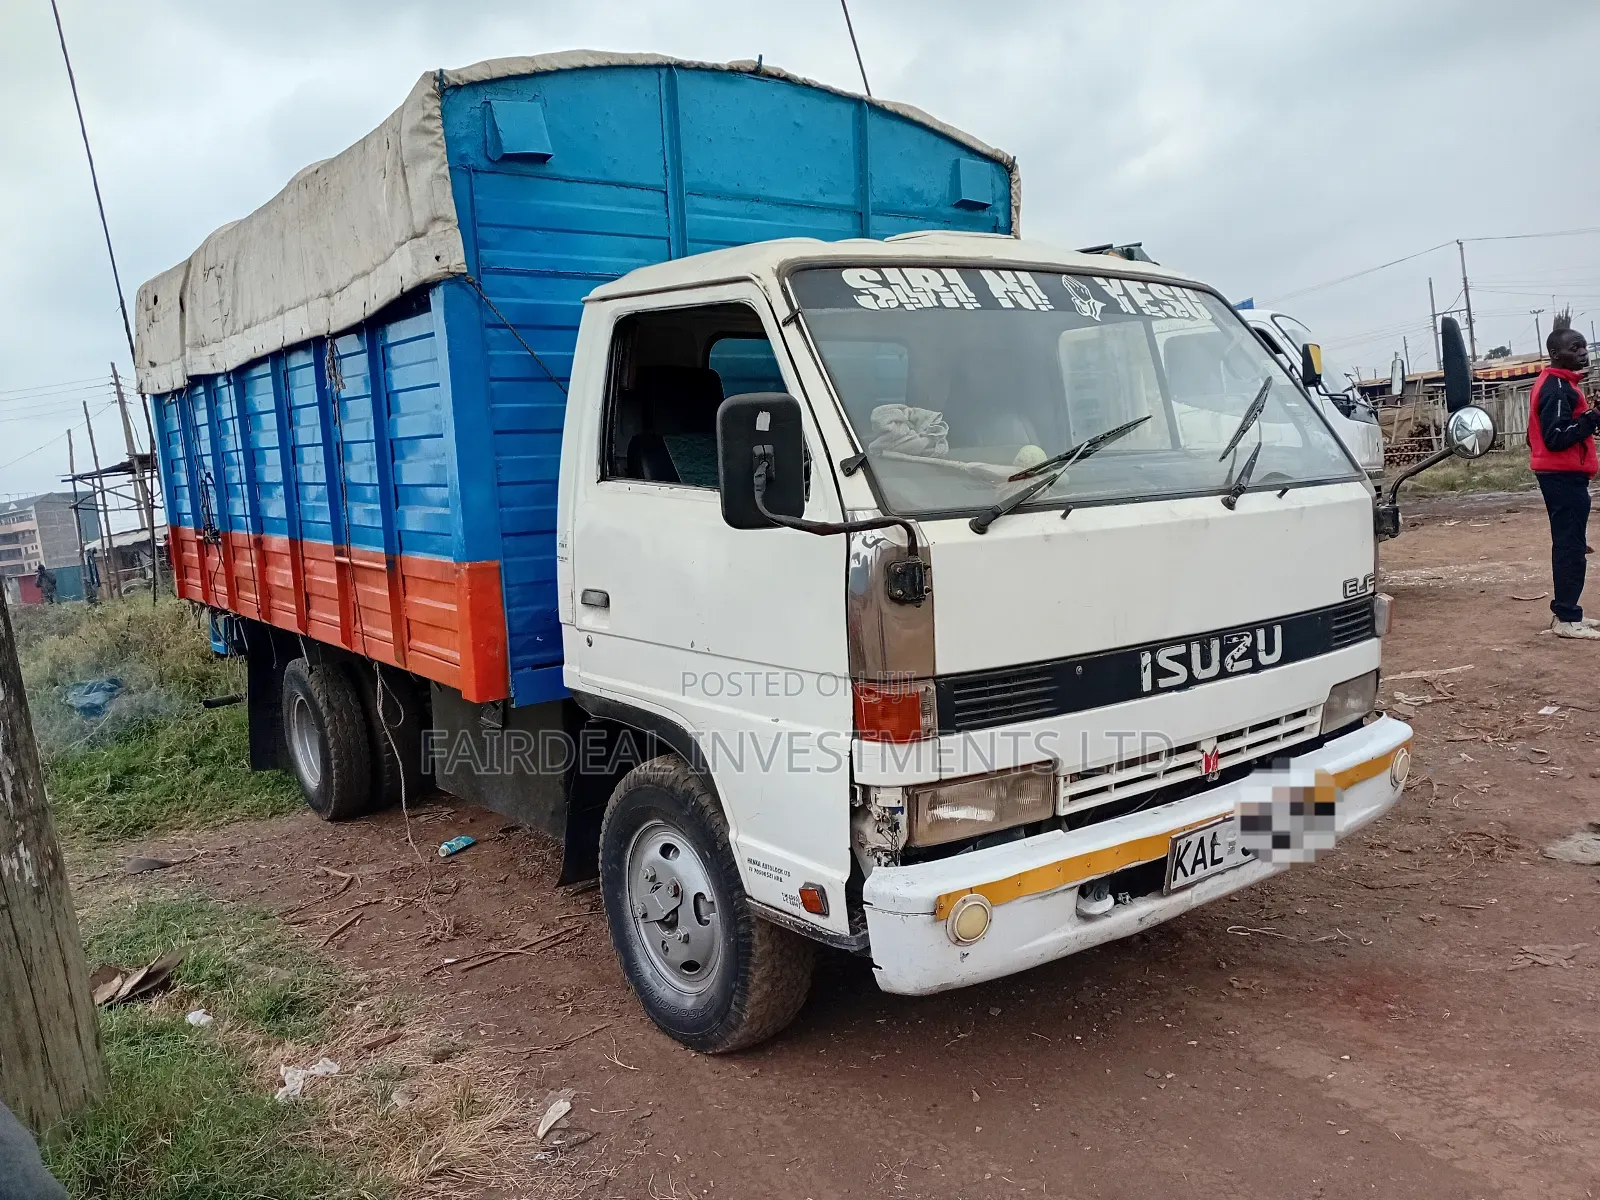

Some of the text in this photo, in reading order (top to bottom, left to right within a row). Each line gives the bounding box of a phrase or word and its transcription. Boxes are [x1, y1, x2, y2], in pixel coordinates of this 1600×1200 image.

[841, 267, 982, 311] SIRI
[979, 269, 1055, 312] NI
[1140, 624, 1283, 692] ISUZU
